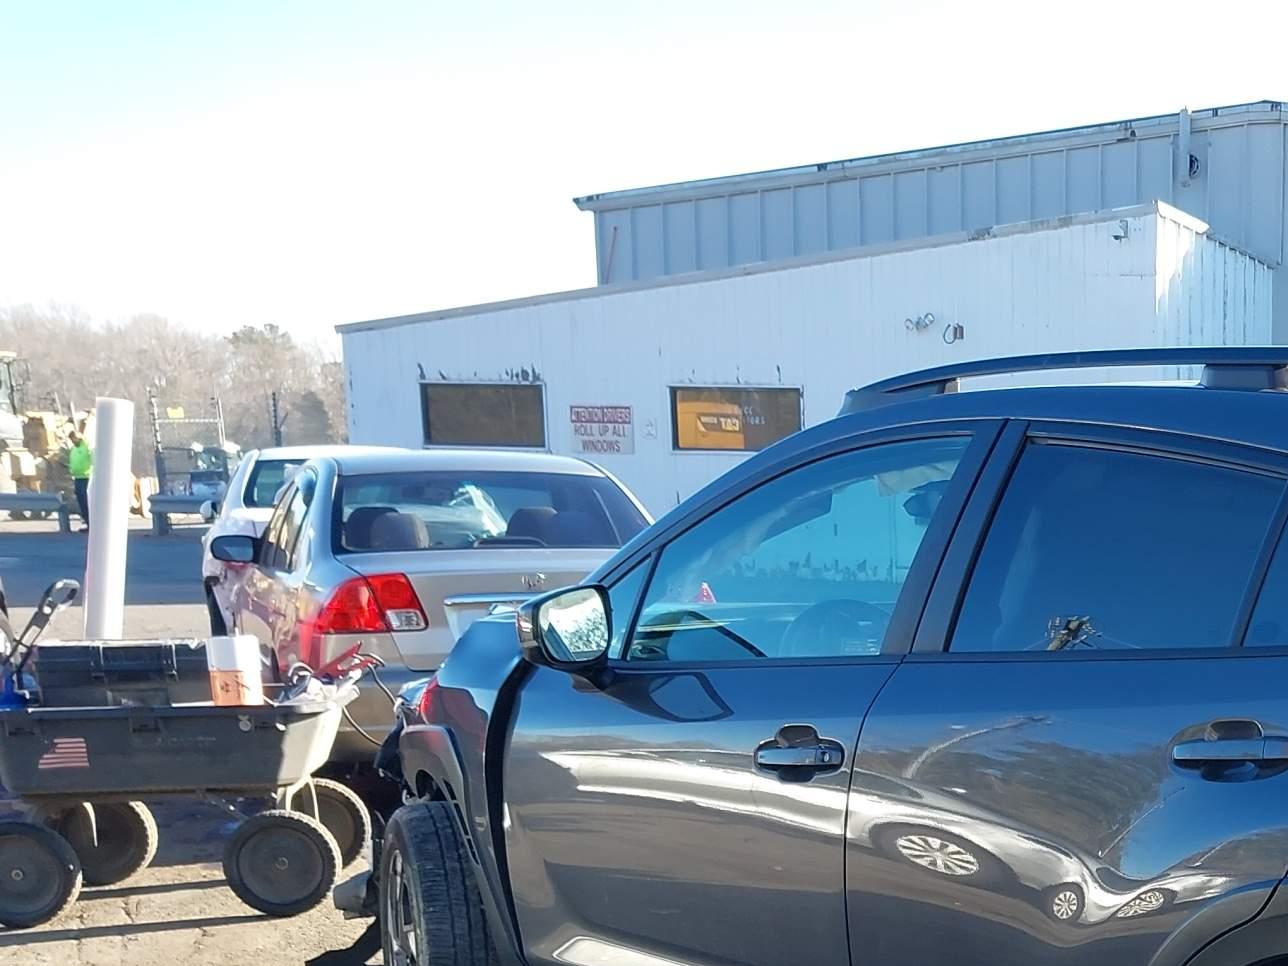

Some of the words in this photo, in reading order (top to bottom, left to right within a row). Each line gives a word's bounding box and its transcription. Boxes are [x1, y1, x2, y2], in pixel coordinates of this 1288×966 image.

[603, 408, 630, 422] DRIVERS
[574, 424, 595, 437] ROLL
[598, 425, 609, 437] UP
[612, 425, 627, 437] ALL
[582, 440, 621, 452] WINDOWS
